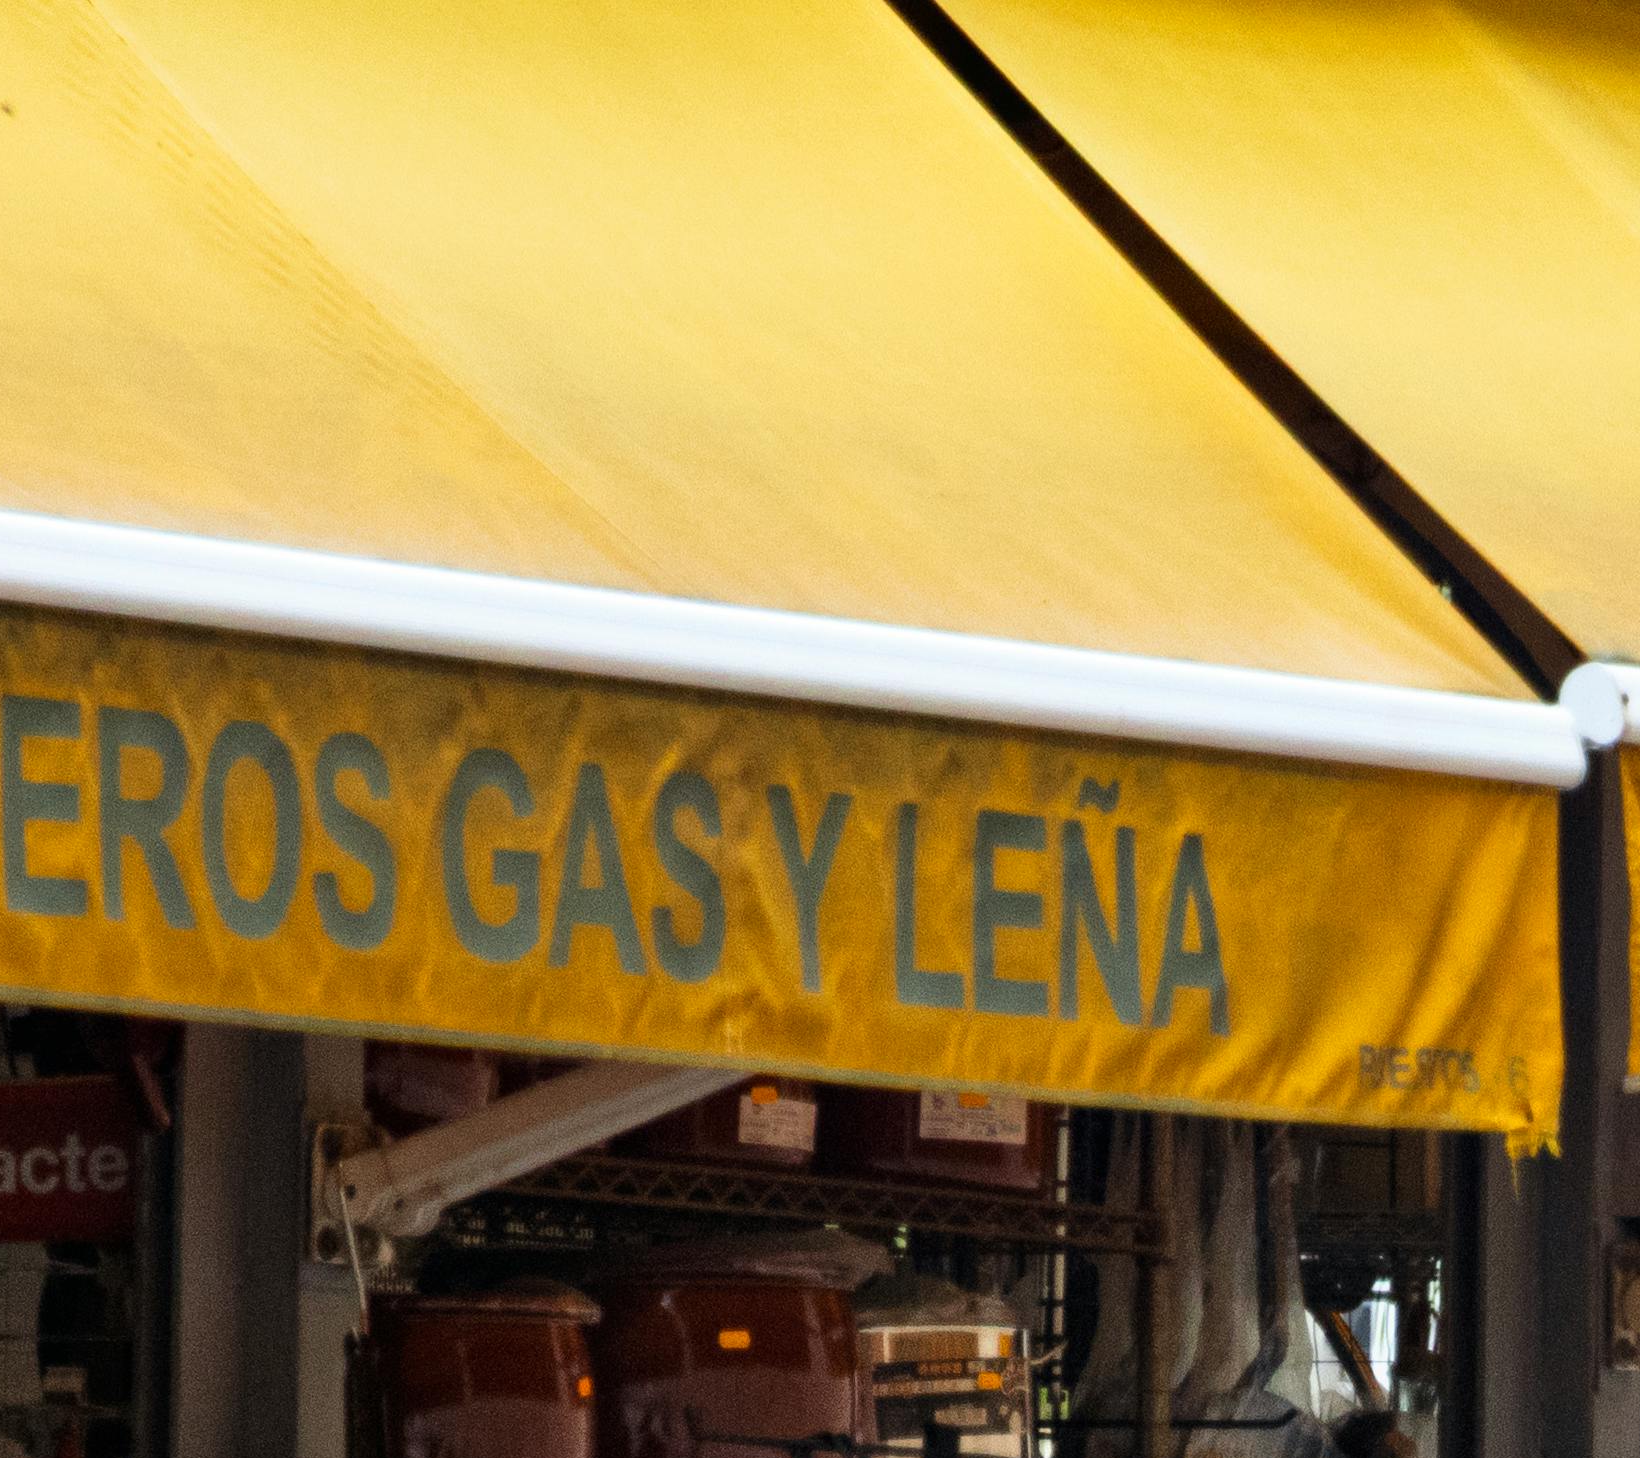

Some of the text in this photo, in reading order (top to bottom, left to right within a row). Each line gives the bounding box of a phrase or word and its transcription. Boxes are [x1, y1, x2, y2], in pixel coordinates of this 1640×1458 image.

[440, 747, 726, 984] GAS
[767, 785, 851, 993] Y
[894, 779, 1230, 1036] LEÑA
